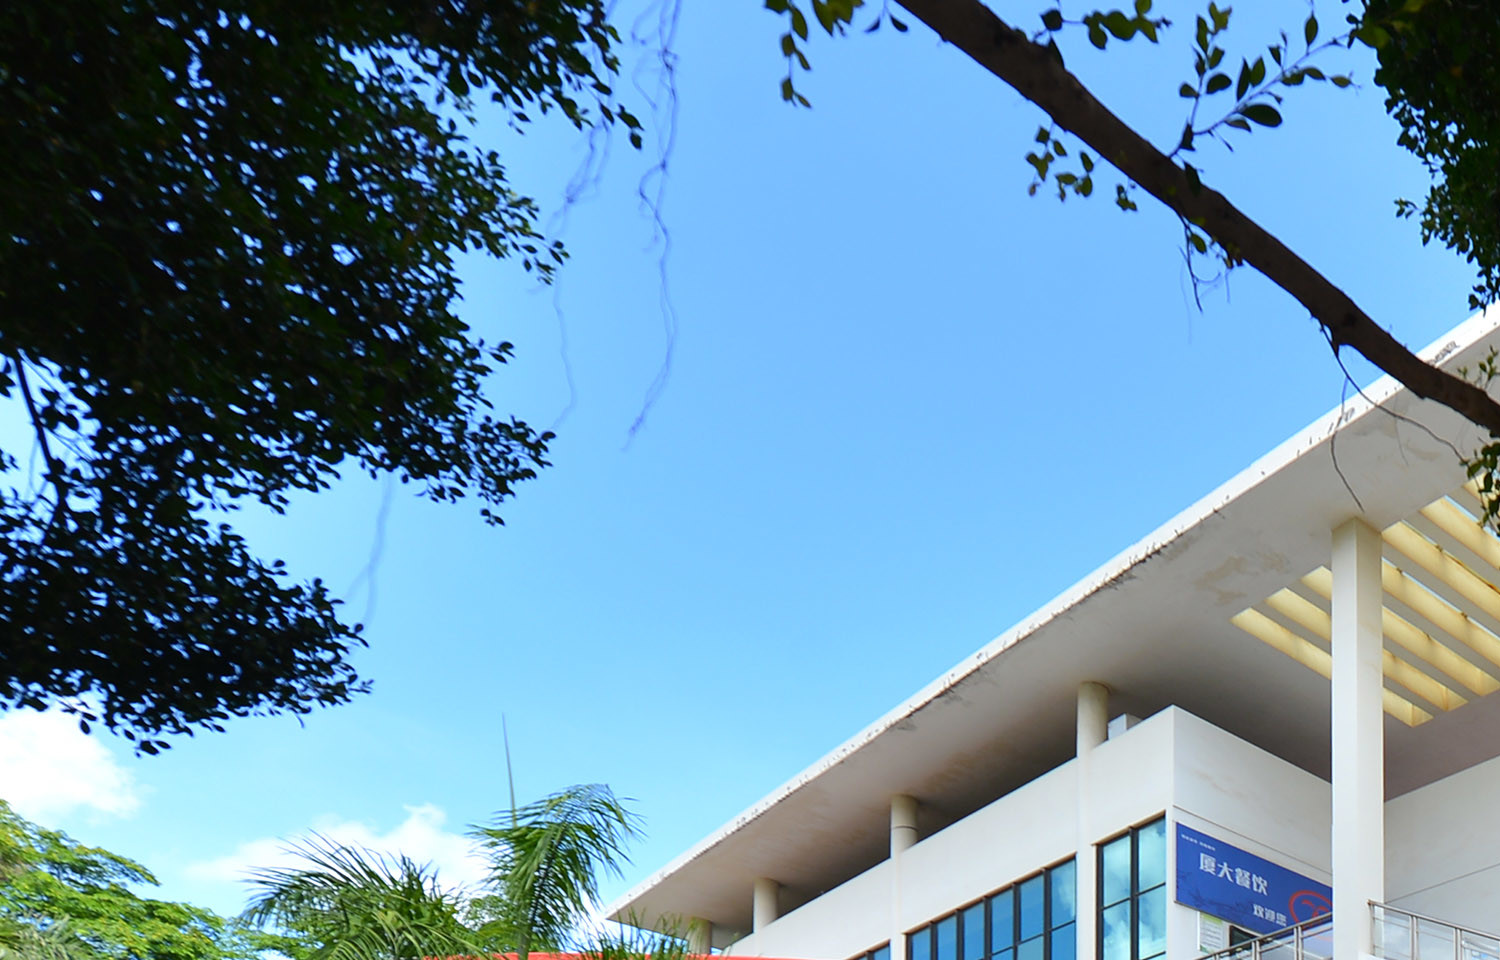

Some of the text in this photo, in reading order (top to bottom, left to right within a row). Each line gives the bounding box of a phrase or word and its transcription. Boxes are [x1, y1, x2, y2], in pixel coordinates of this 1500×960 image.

[1199, 852, 1268, 896] 厦大餐饮
[1253, 903, 1288, 927] 欢迎您
